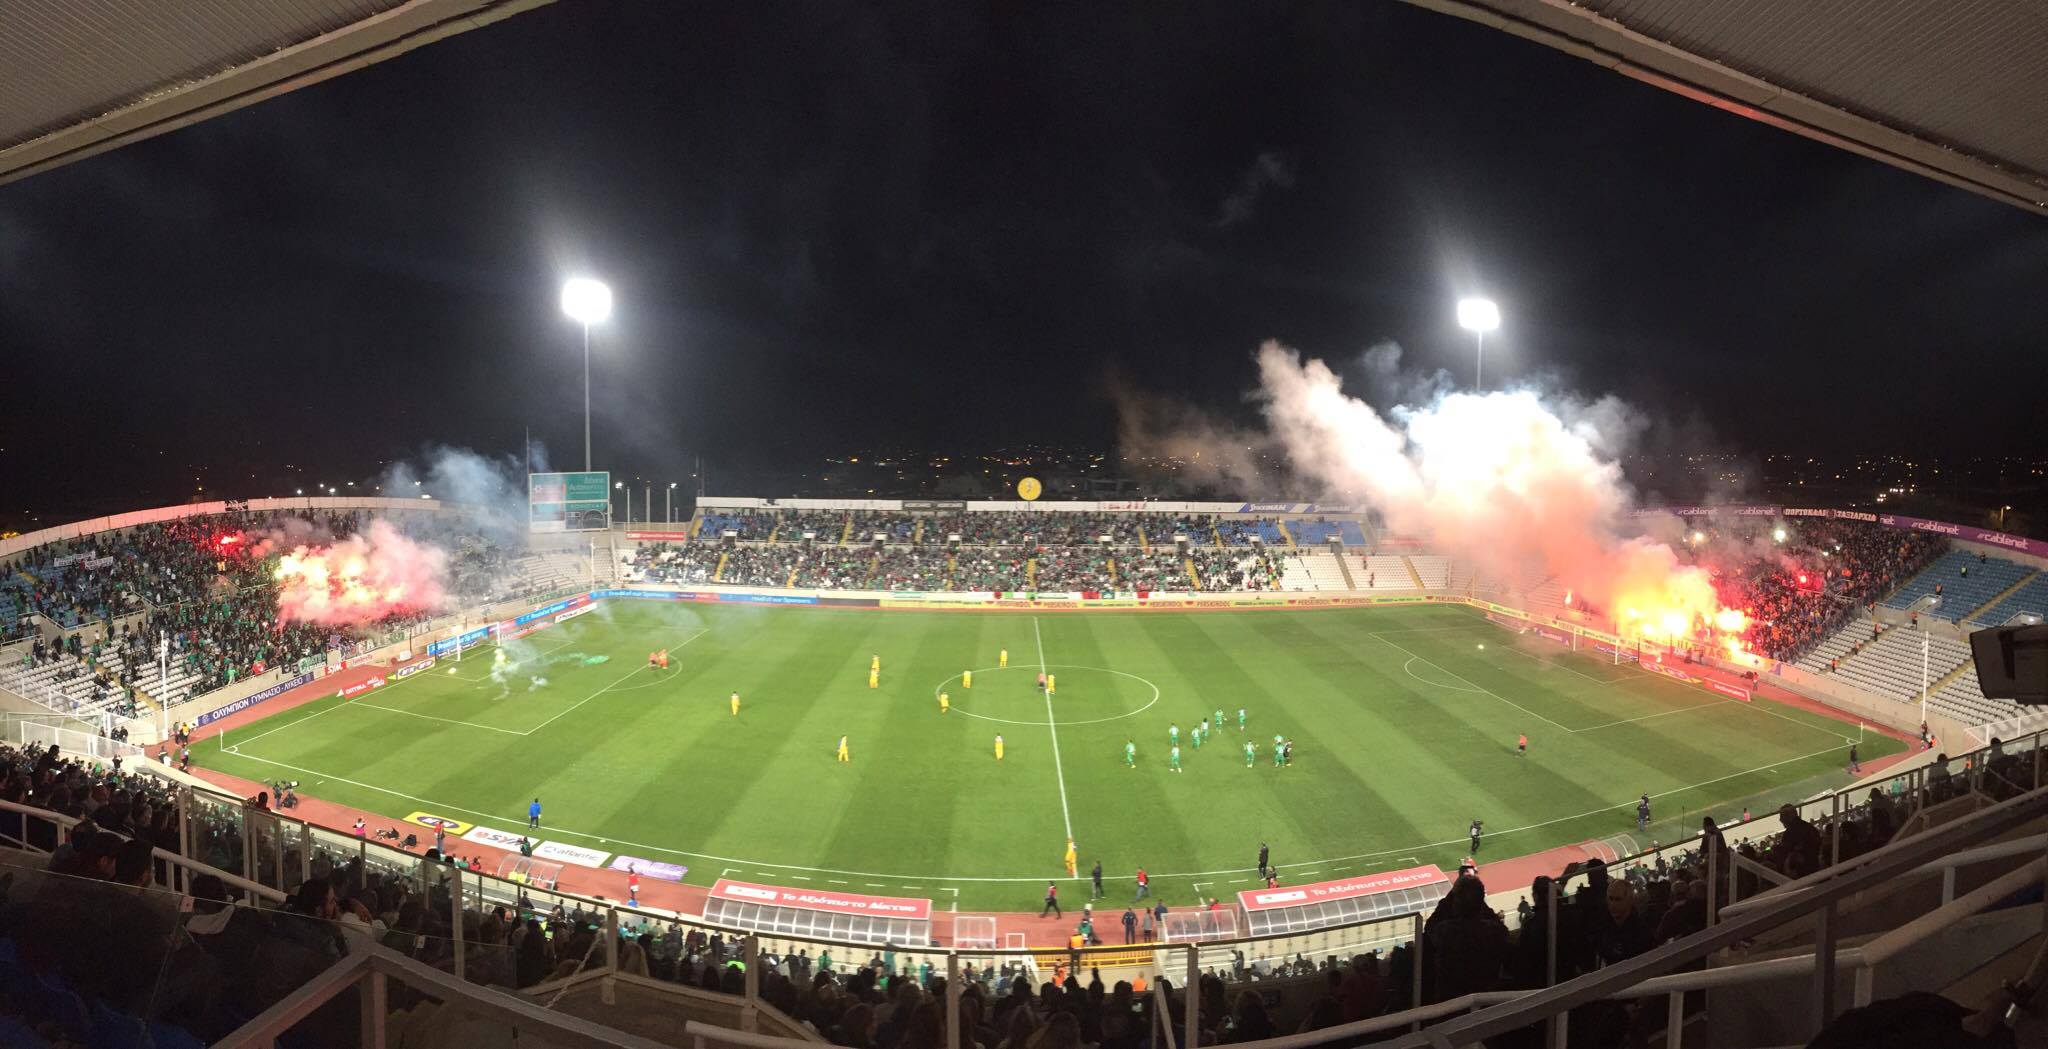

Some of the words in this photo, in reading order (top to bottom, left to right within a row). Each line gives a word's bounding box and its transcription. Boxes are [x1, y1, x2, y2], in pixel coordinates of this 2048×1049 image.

[1683, 507, 1717, 516] cablenet
[1739, 507, 1776, 516] cablenet
[1918, 521, 1960, 536] cablenet
[1984, 532, 2029, 550] cablenet
[328, 663, 343, 675] SYM
[212, 698, 249, 720] ΟΛΥΜΠΙΟΝ
[251, 686, 281, 704] ΓΥΜΝΑΣΙΟ
[284, 678, 303, 691] ΛΥΚΕΙΟ
[1311, 888, 1325, 896] Το
[1328, 878, 1390, 894] Αξιόπιστο
[1392, 871, 1432, 885] Δίκτυο
[782, 893, 796, 901] Το
[799, 893, 867, 909] Αξιόπιστο
[869, 901, 917, 912] Δίκτυο
